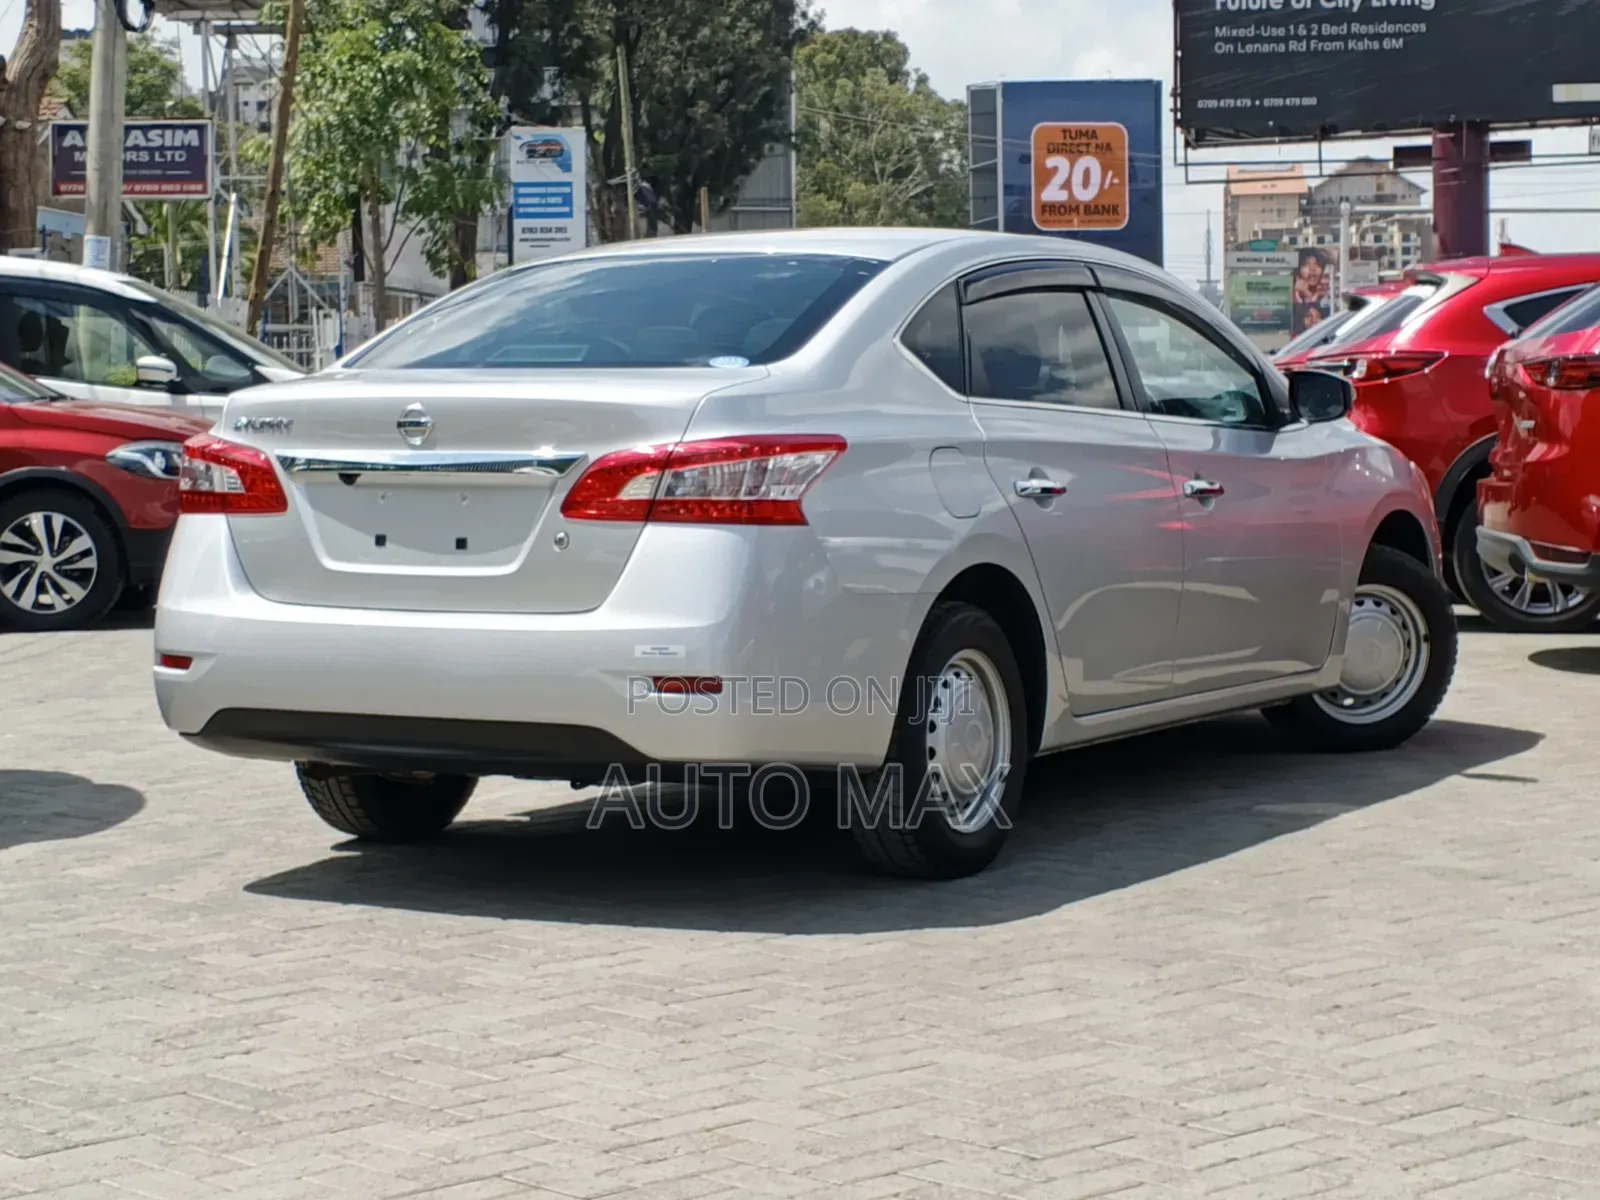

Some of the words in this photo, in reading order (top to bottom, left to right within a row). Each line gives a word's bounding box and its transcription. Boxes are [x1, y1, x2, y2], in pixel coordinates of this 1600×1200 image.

[1215, 25, 1286, 38] Mixed-Use
[1310, 26, 1319, 36] 2
[1321, 23, 1348, 36] Bed
[1351, 21, 1427, 35] Residences
[1214, 42, 1235, 54] On
[1237, 41, 1286, 54] Lenana
[1288, 39, 1308, 52] Rd
[1310, 39, 1345, 52] From
[1348, 37, 1379, 51] Kshs
[1382, 37, 1404, 50] 6M
[1061, 128, 1098, 141] TUMA
[1047, 142, 1091, 155] DIRECT
[1094, 142, 1114, 154] NA
[155, 151, 188, 163] LTD
[1041, 203, 1080, 217] FROM
[1083, 203, 1120, 217] BANK
